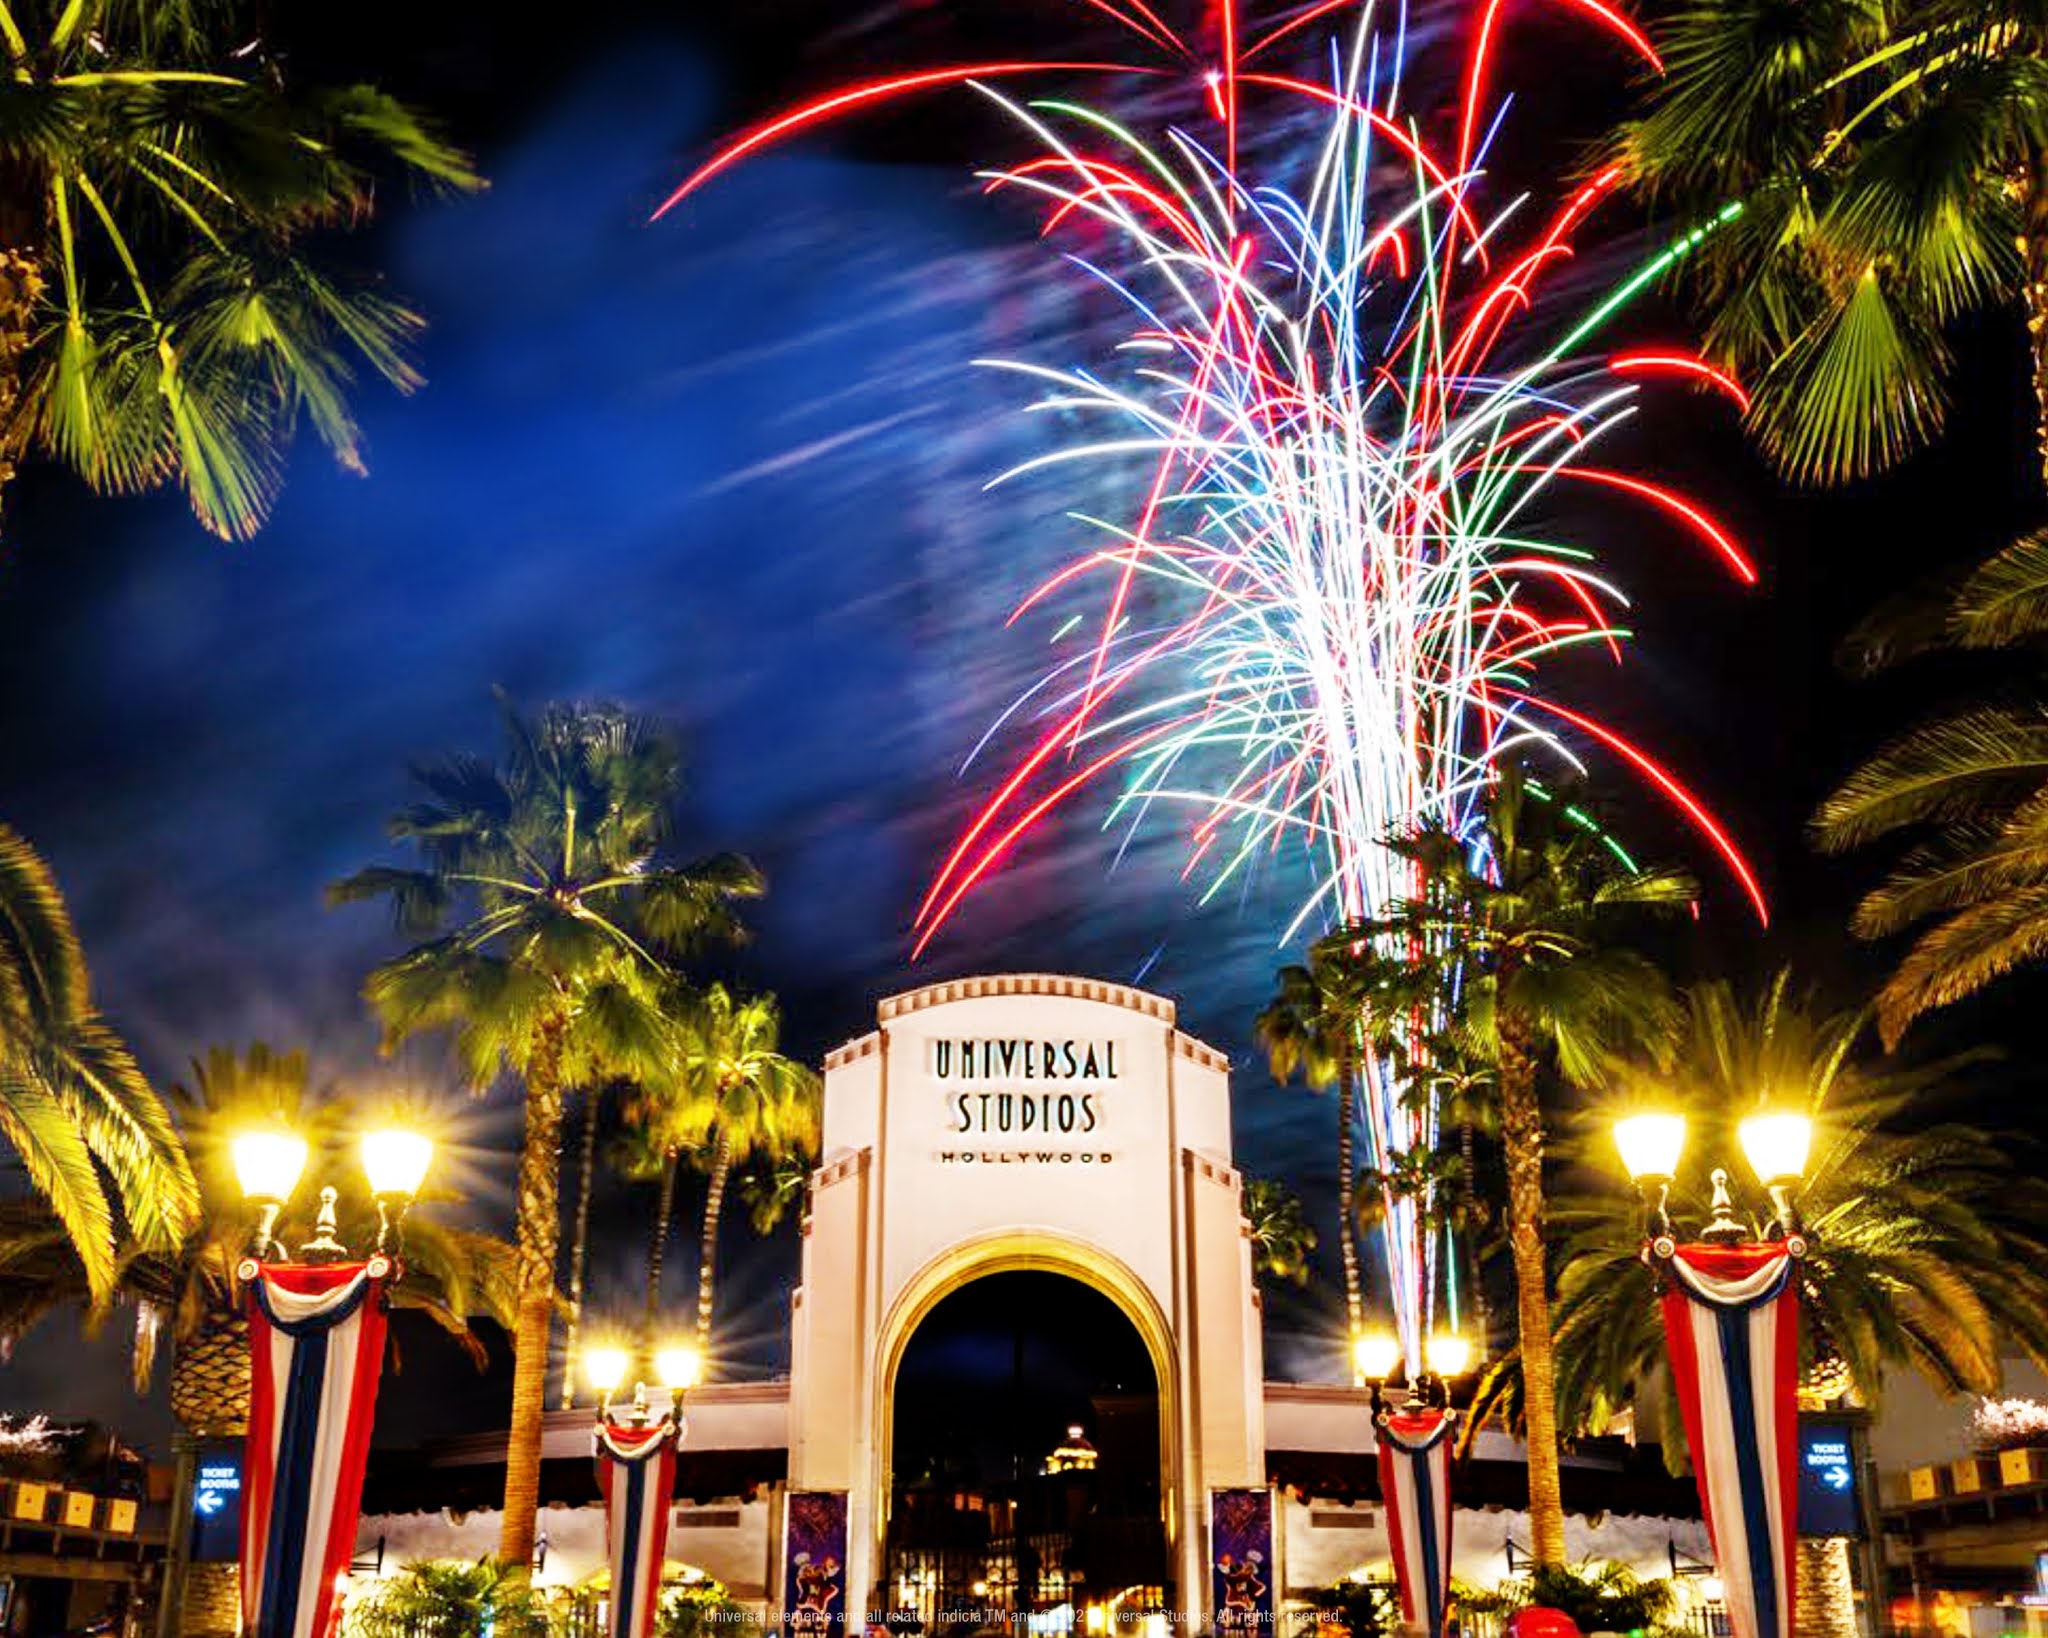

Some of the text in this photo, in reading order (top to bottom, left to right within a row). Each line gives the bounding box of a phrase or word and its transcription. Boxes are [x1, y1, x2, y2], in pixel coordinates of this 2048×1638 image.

[936, 1040, 1118, 1079] UNIVERSAL
[958, 1093, 1096, 1133] STUDIOS
[941, 1152, 1113, 1163] HOLLYWOOD
[1811, 1443, 1846, 1453] TICKET
[201, 1468, 236, 1478] TICKET
[200, 1478, 240, 1489] BOOTHS
